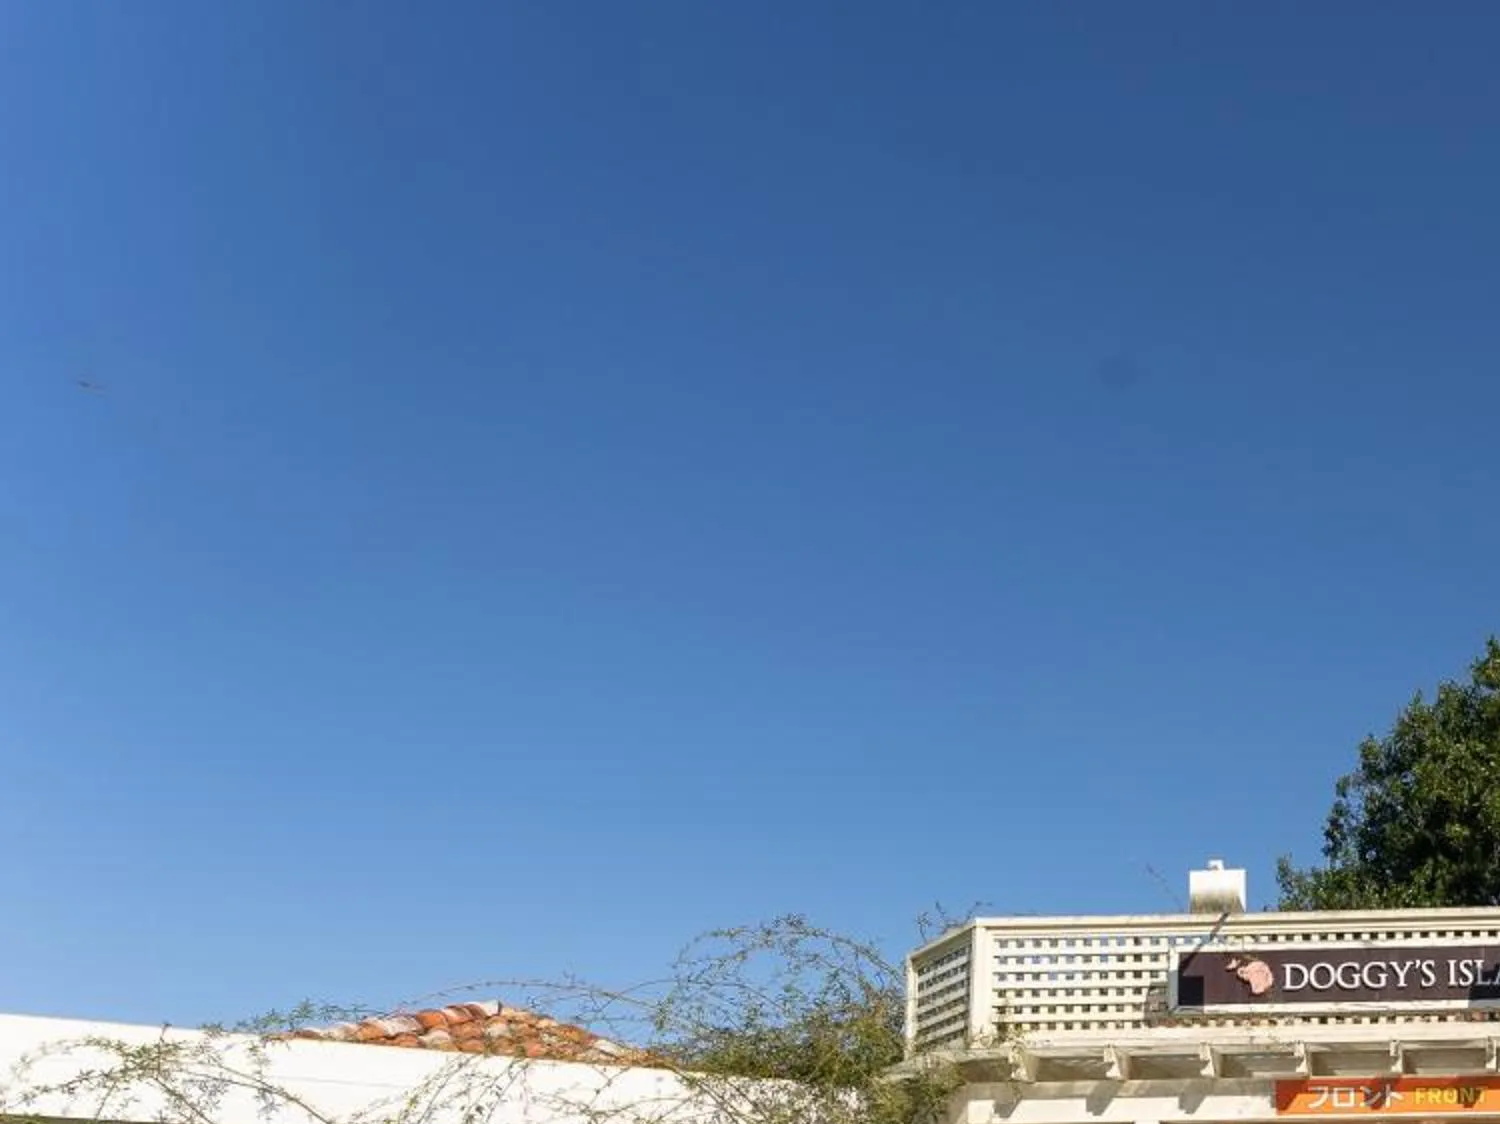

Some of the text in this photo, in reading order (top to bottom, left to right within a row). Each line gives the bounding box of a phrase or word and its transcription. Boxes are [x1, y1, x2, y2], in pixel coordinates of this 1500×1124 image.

[1283, 959, 1436, 991] DOGGY'S
[1308, 1084, 1489, 1109] フロント FRONT
